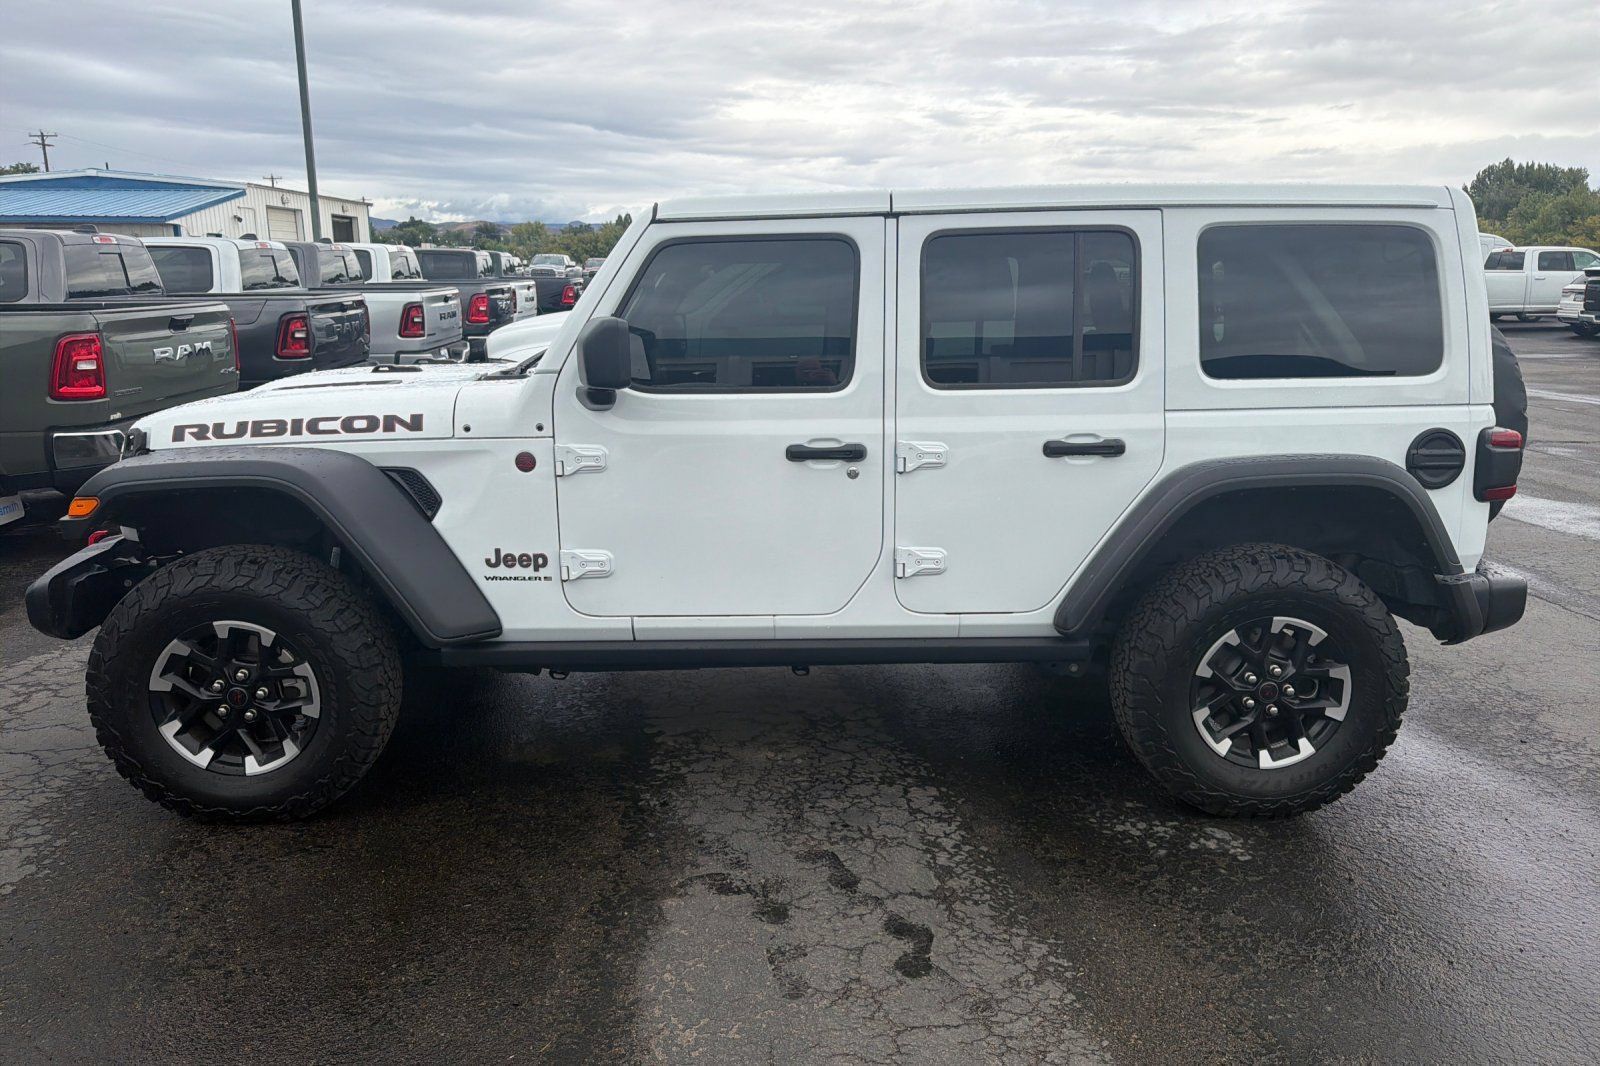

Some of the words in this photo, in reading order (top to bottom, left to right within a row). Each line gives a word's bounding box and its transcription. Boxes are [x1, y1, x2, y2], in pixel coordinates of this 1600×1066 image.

[154, 342, 213, 363] RAM
[172, 414, 424, 442] RUBICON
[484, 548, 549, 572] Jeep
